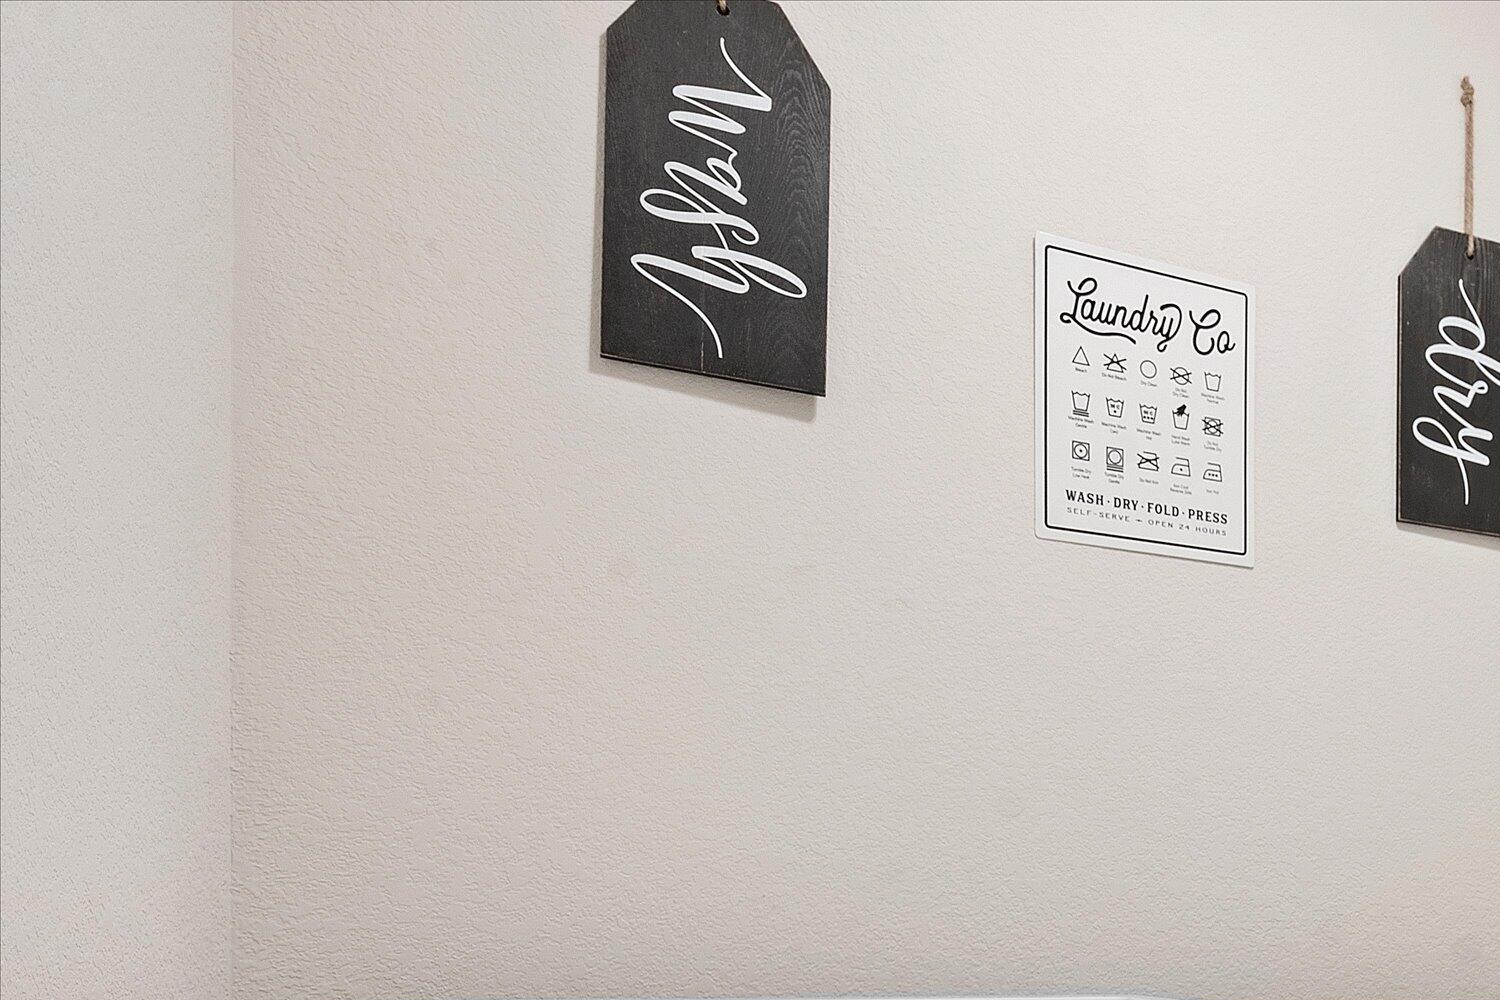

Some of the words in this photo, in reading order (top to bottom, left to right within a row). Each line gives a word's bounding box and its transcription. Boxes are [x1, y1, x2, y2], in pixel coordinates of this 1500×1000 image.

[1059, 277, 1183, 353] Laundry
[1188, 309, 1236, 356] Co
[1065, 489, 1104, 506] WASH
[1113, 496, 1139, 511] DRY
[1147, 501, 1180, 517] FOLD
[1188, 508, 1229, 525] PRESS
[1066, 506, 1131, 523] SELF-SERVE
[1147, 519, 1174, 528] OPEN
[1178, 523, 1191, 531] 24
[1195, 525, 1228, 537] HOURS
